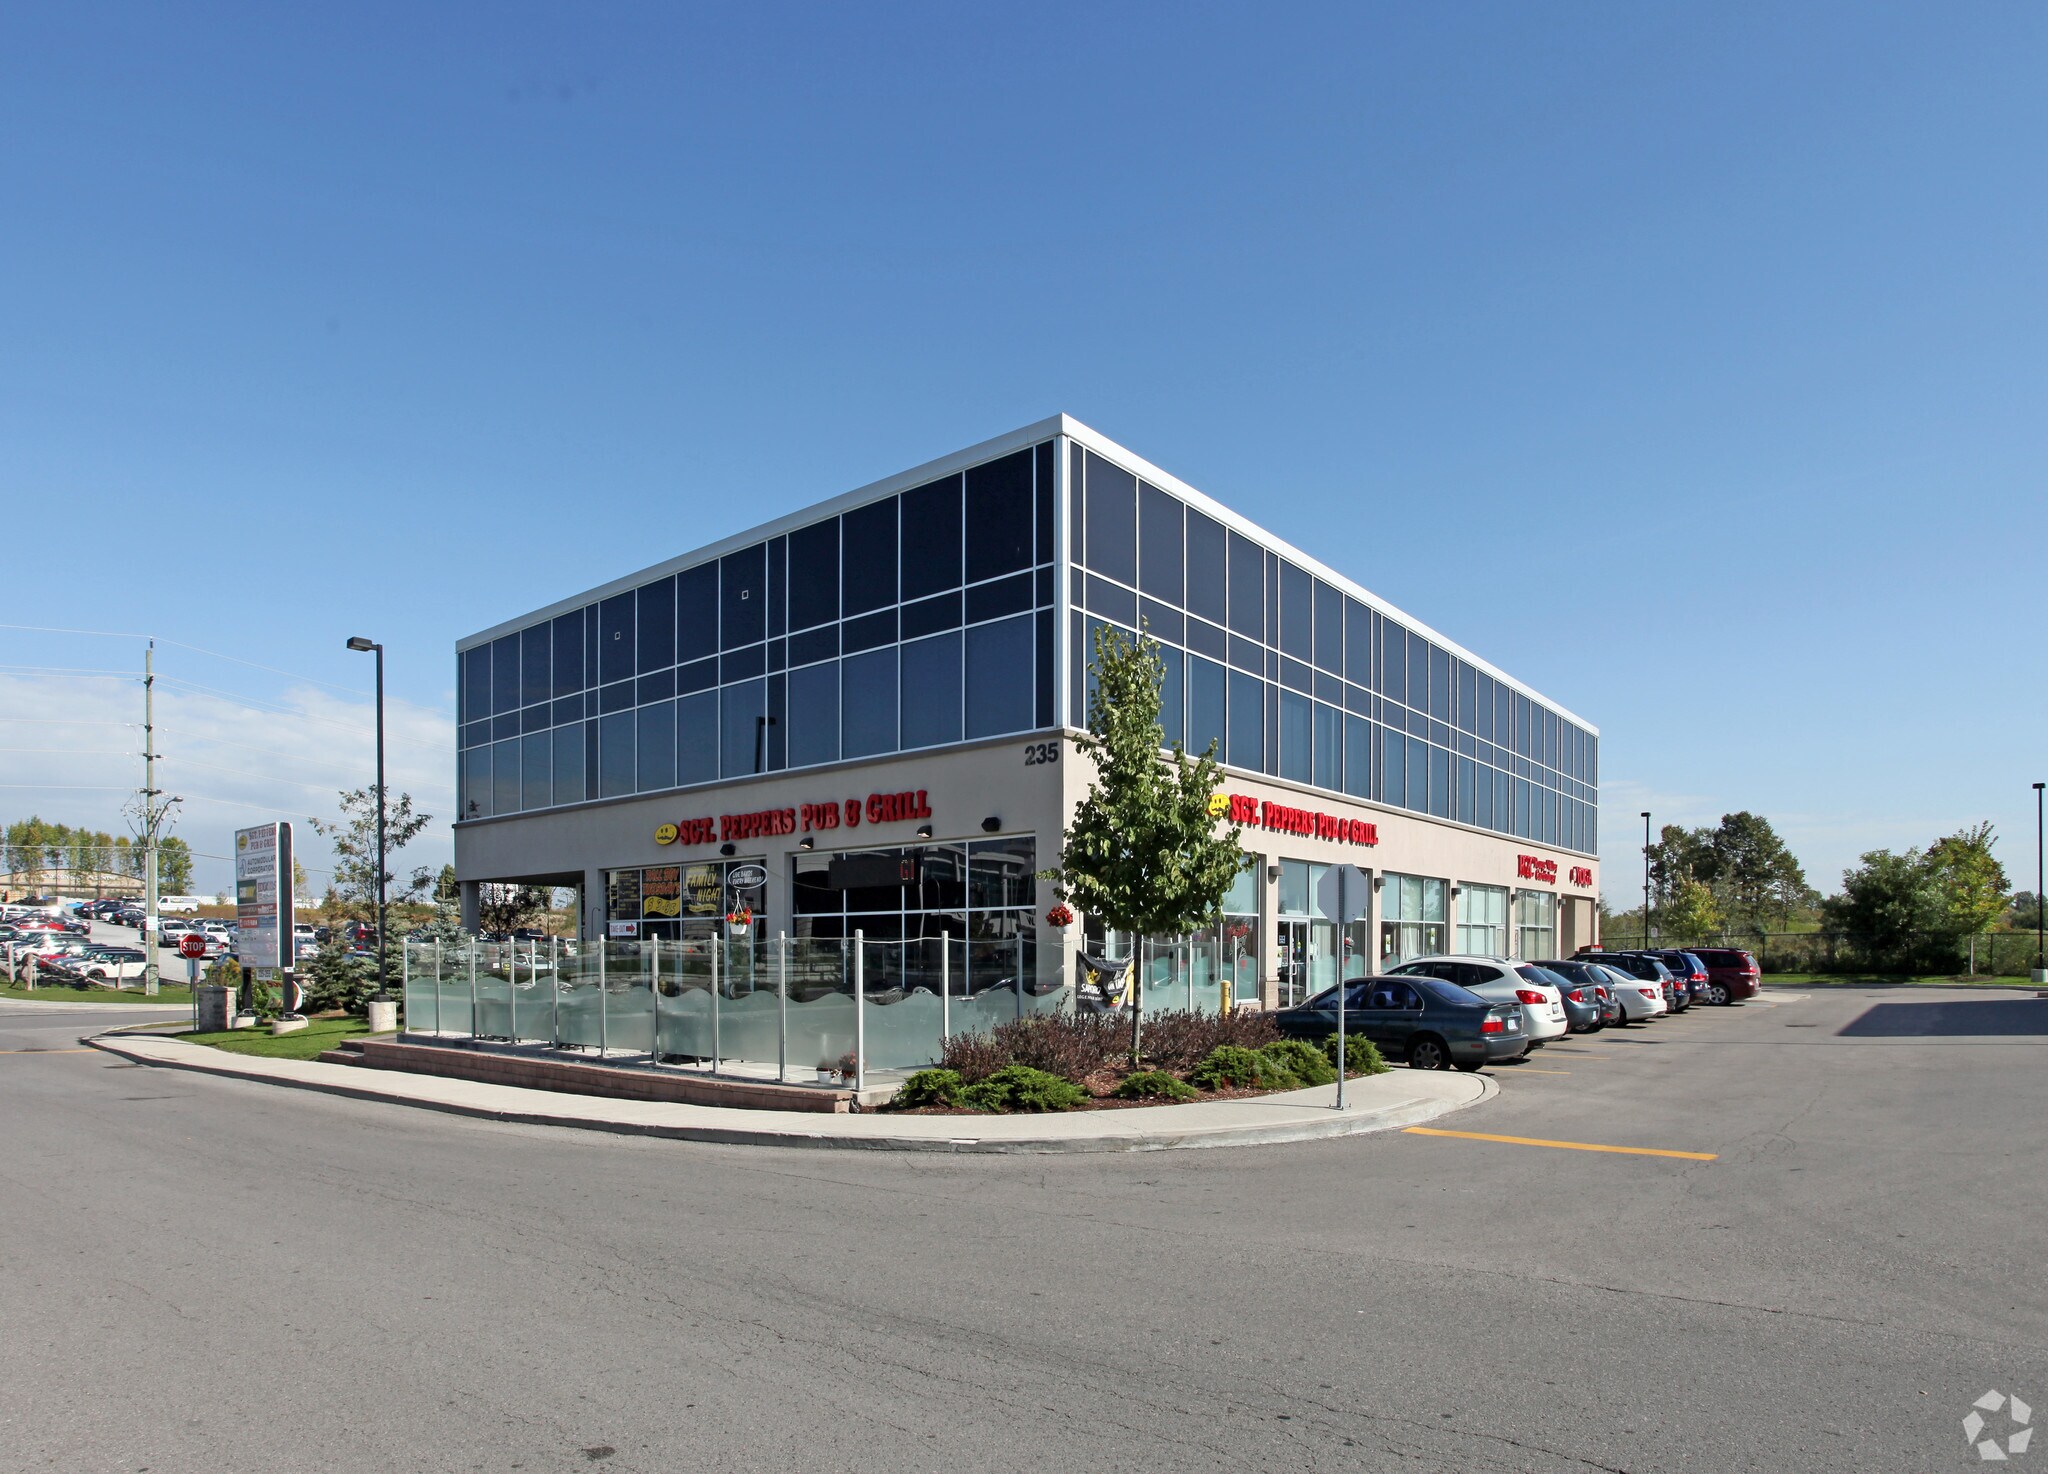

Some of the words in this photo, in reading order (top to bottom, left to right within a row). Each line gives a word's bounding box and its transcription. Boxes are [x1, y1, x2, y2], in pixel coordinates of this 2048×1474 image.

[1025, 742, 1058, 766] 235
[680, 819, 717, 845] SGT.
[720, 808, 796, 841] PEPPERS
[800, 802, 839, 832] PUB
[844, 799, 861, 827] &
[866, 790, 931, 824] GRILL
[1230, 794, 1260, 825] SGT.
[1263, 801, 1314, 834] PEPPERS
[1315, 812, 1339, 839] PUB
[1339, 818, 1348, 841] &
[1350, 819, 1378, 845] GRILL
[685, 873, 717, 888] FAMILY
[696, 887, 721, 902] NIGHT
[182, 941, 205, 952] STOP
